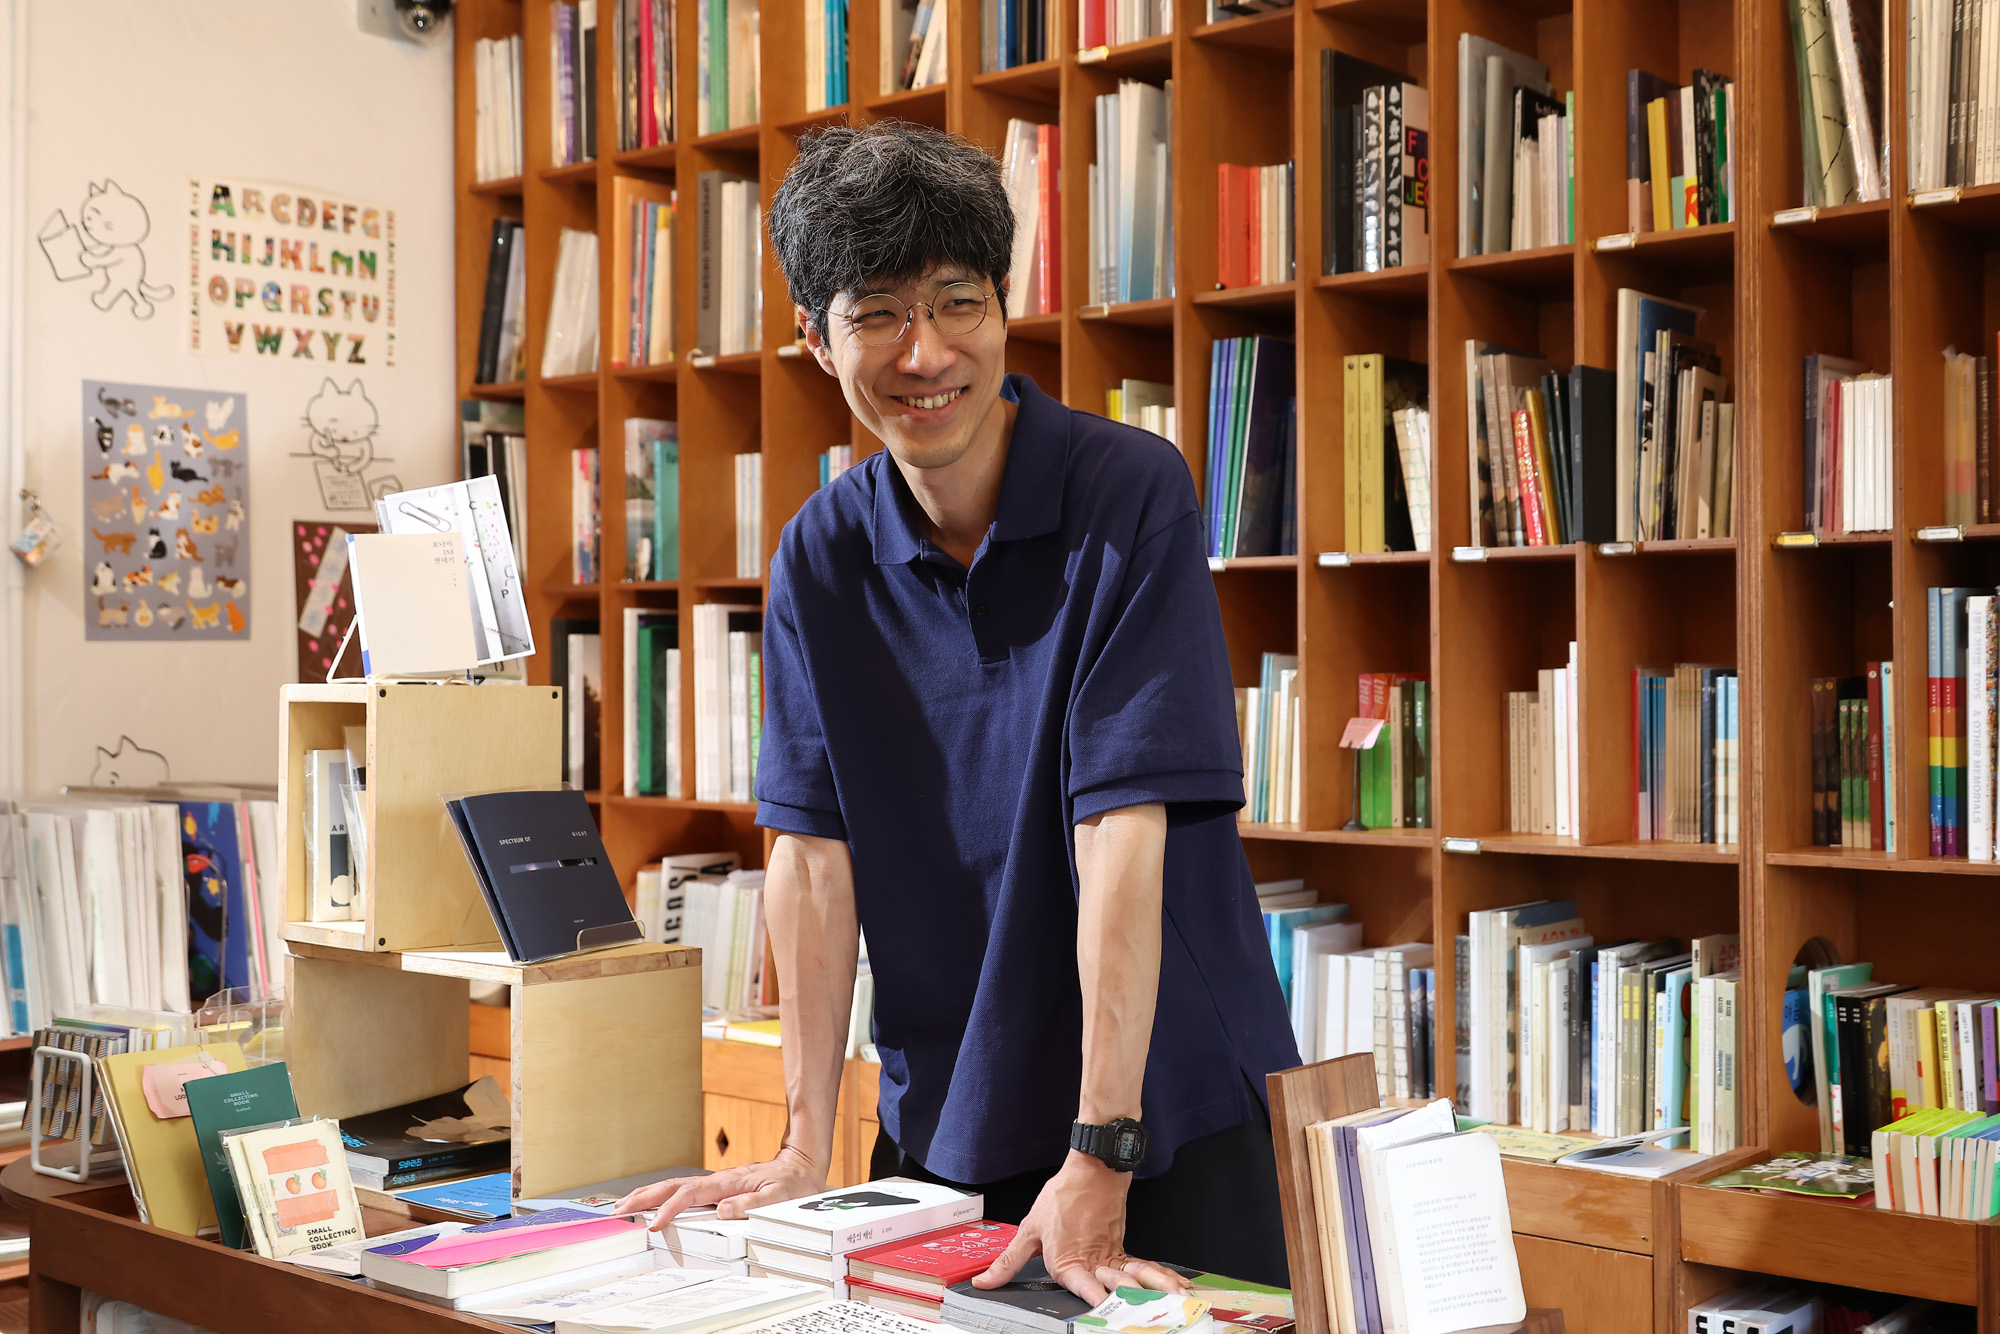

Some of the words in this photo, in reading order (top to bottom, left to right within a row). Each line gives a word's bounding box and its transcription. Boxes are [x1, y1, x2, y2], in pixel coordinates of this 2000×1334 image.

[1973, 672, 1982, 700] TOYS
[1973, 720, 1982, 757] OTHER
[1973, 760, 1982, 824] MEMORIALS
[499, 837, 525, 846] SPECTRUM
[223, 1093, 258, 1104] COLLECTING
[307, 1226, 333, 1236] SMALL
[309, 1228, 357, 1243] COLLECTING
[311, 1242, 333, 1251] BOOK
